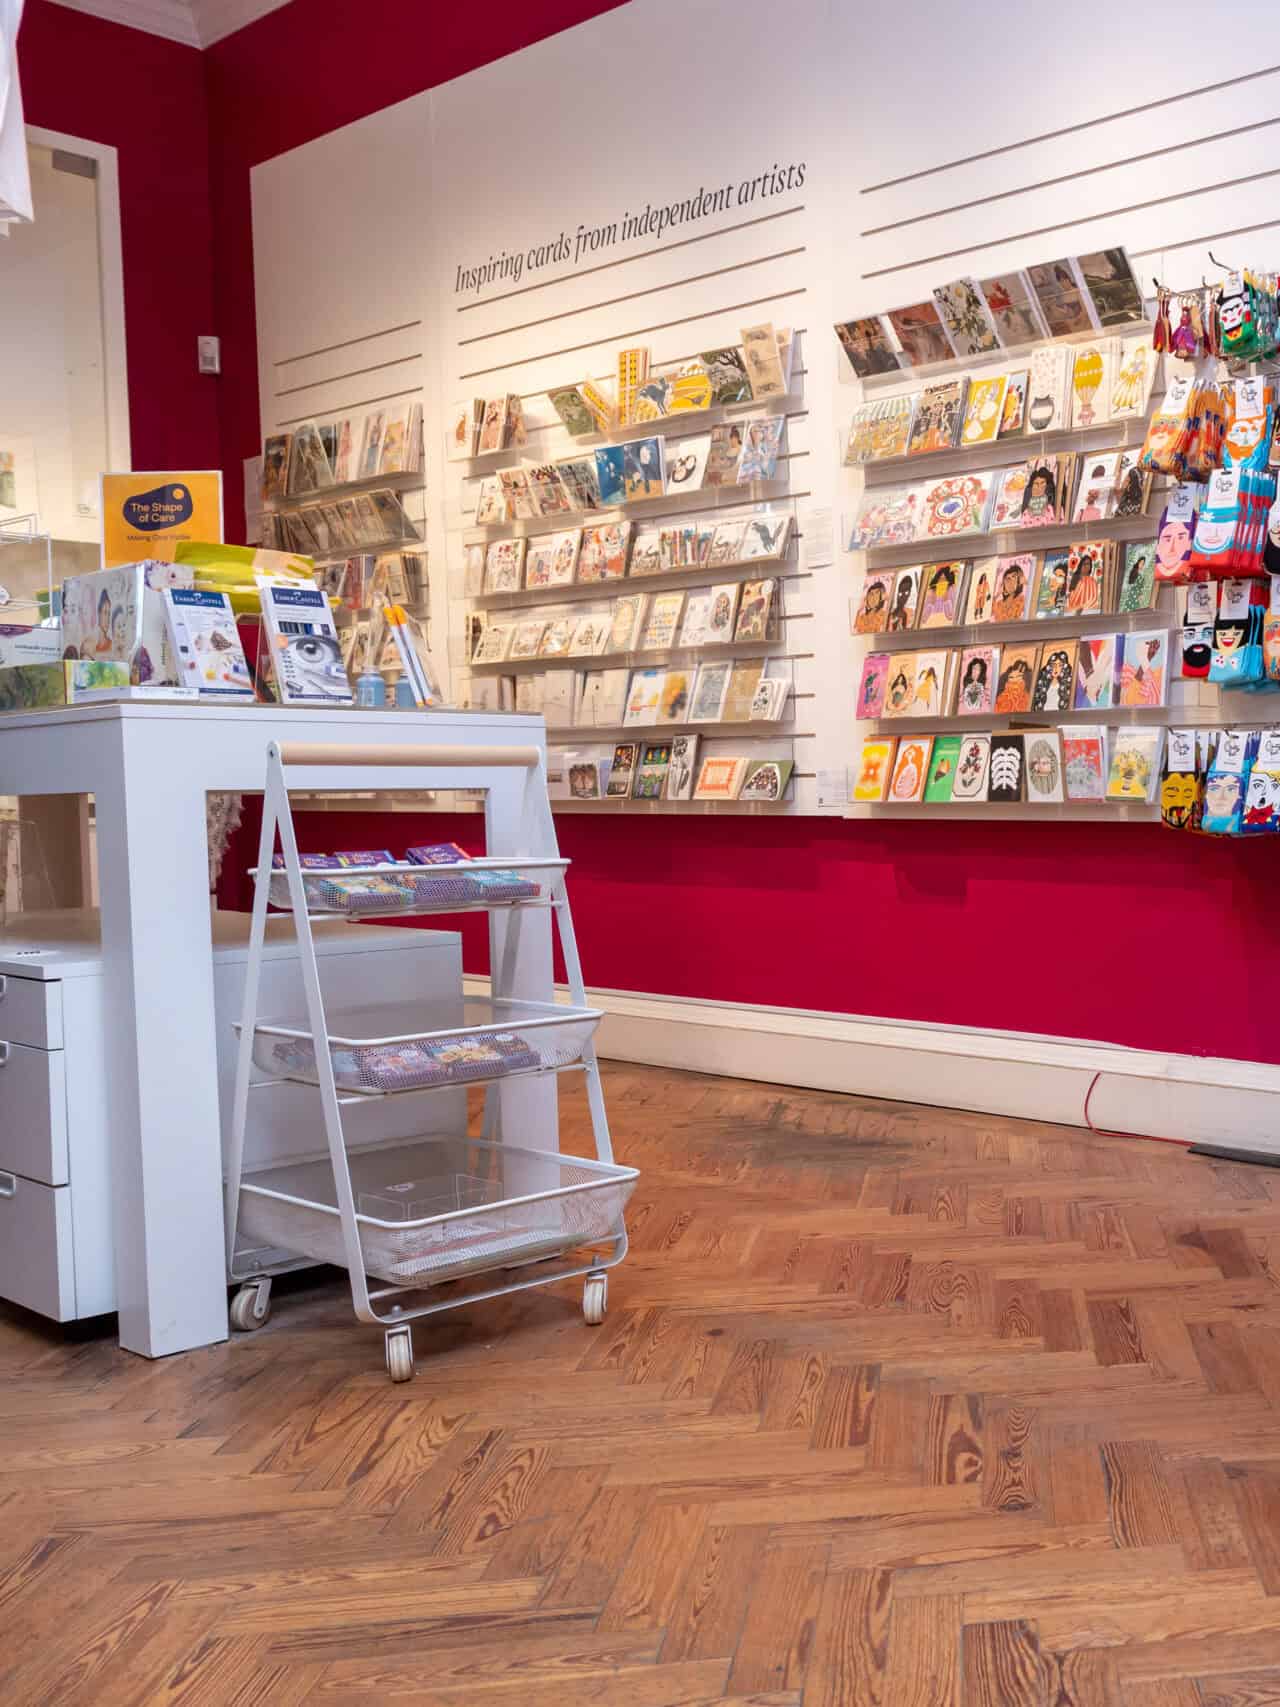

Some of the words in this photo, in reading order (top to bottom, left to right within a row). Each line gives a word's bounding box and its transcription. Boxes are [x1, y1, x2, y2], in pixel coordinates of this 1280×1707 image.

[455, 251, 524, 294] Inspiring
[527, 232, 571, 270] cards
[574, 224, 617, 264] from
[621, 186, 734, 240] independent
[738, 162, 806, 205] artists
[131, 503, 150, 513] The
[151, 502, 184, 514] Shape
[138, 513, 149, 523] of
[151, 513, 176, 523] Care
